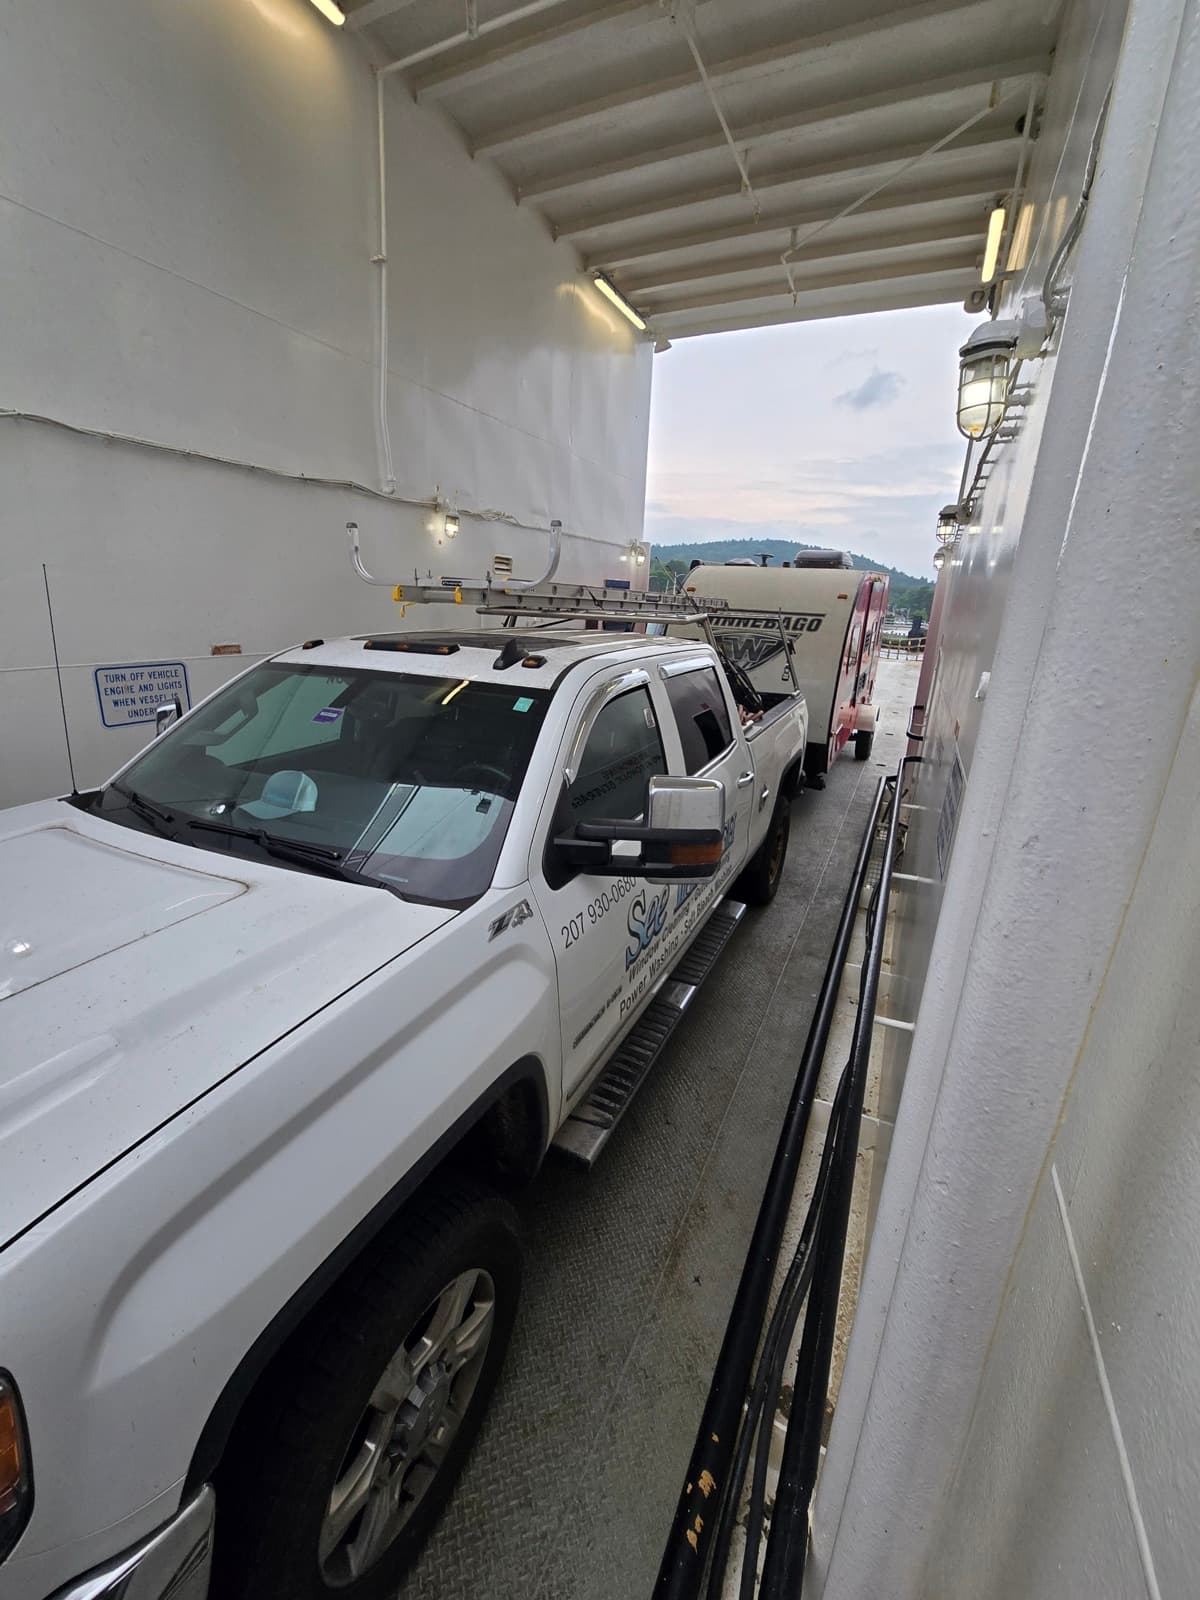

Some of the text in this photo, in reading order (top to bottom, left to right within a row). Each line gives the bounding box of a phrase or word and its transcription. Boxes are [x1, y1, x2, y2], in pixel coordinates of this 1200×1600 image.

[104, 669, 180, 684] TURN OFF VEHICLE
[139, 683, 154, 693] AND
[157, 680, 183, 691] LIGHTS
[112, 697, 136, 708] WHEN
[128, 707, 158, 719] UNDER
[561, 912, 585, 950] 207
[587, 876, 637, 925] 930-0680
[625, 884, 670, 972] See
[620, 976, 648, 1018] Power
[648, 935, 679, 979] Washing
